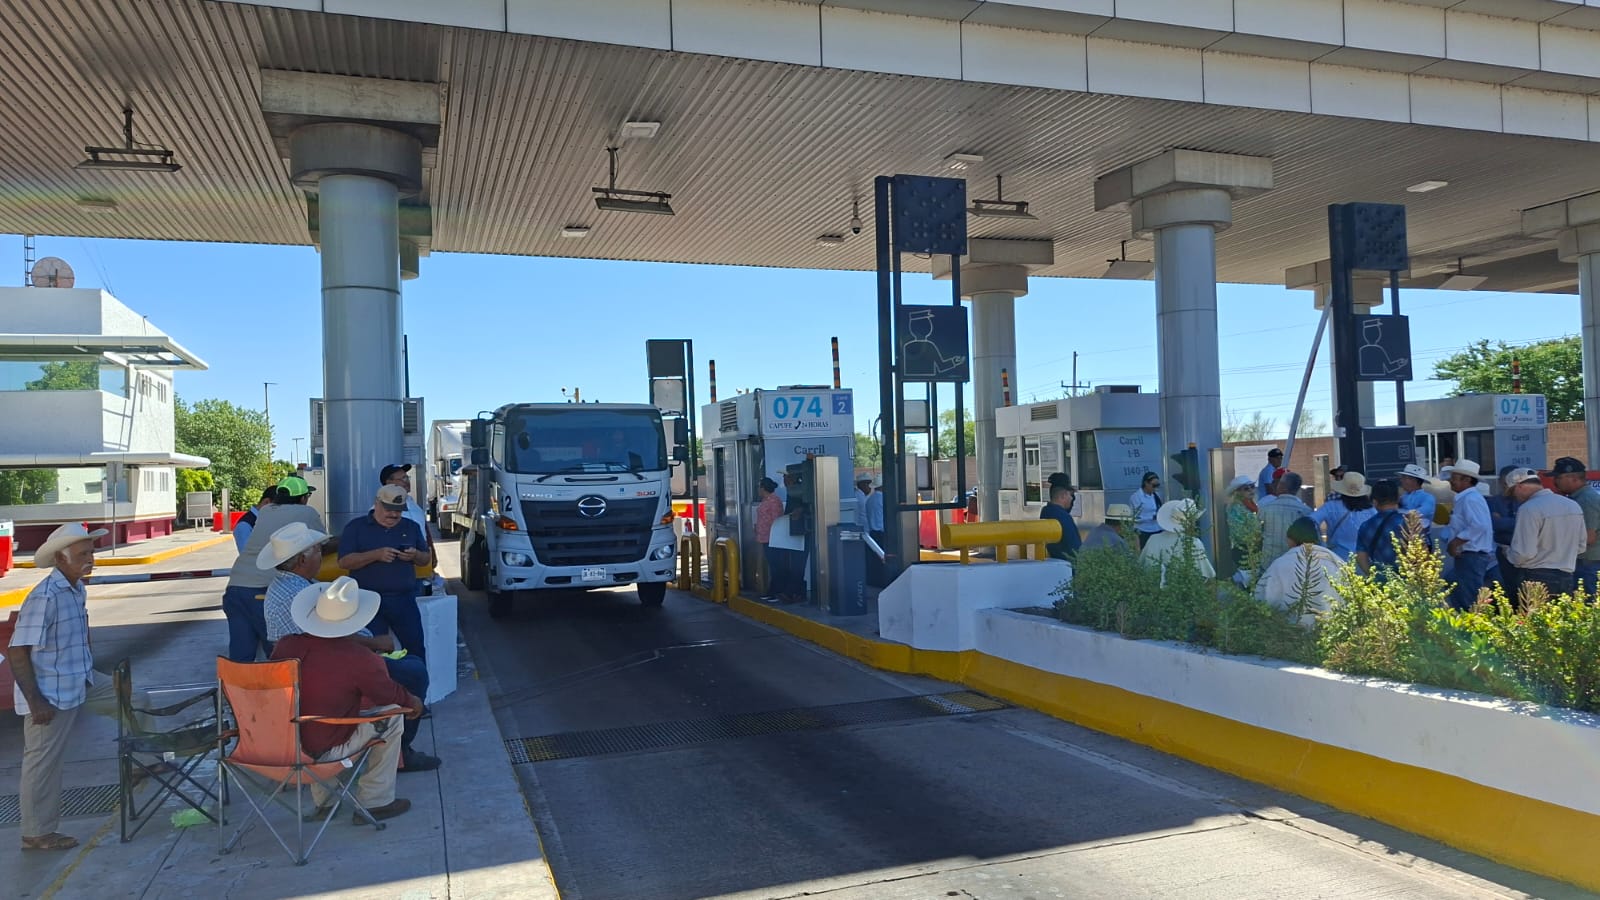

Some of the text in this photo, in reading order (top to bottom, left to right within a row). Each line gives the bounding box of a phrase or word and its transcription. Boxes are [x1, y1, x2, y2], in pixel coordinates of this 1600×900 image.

[772, 396, 823, 419] 074
[838, 401, 846, 413] 2
[1501, 398, 1530, 415] 074
[808, 420, 829, 428] HORAS
[1119, 435, 1144, 446] Carril
[793, 443, 825, 455] Carril
[1127, 448, 1141, 458] 1-B
